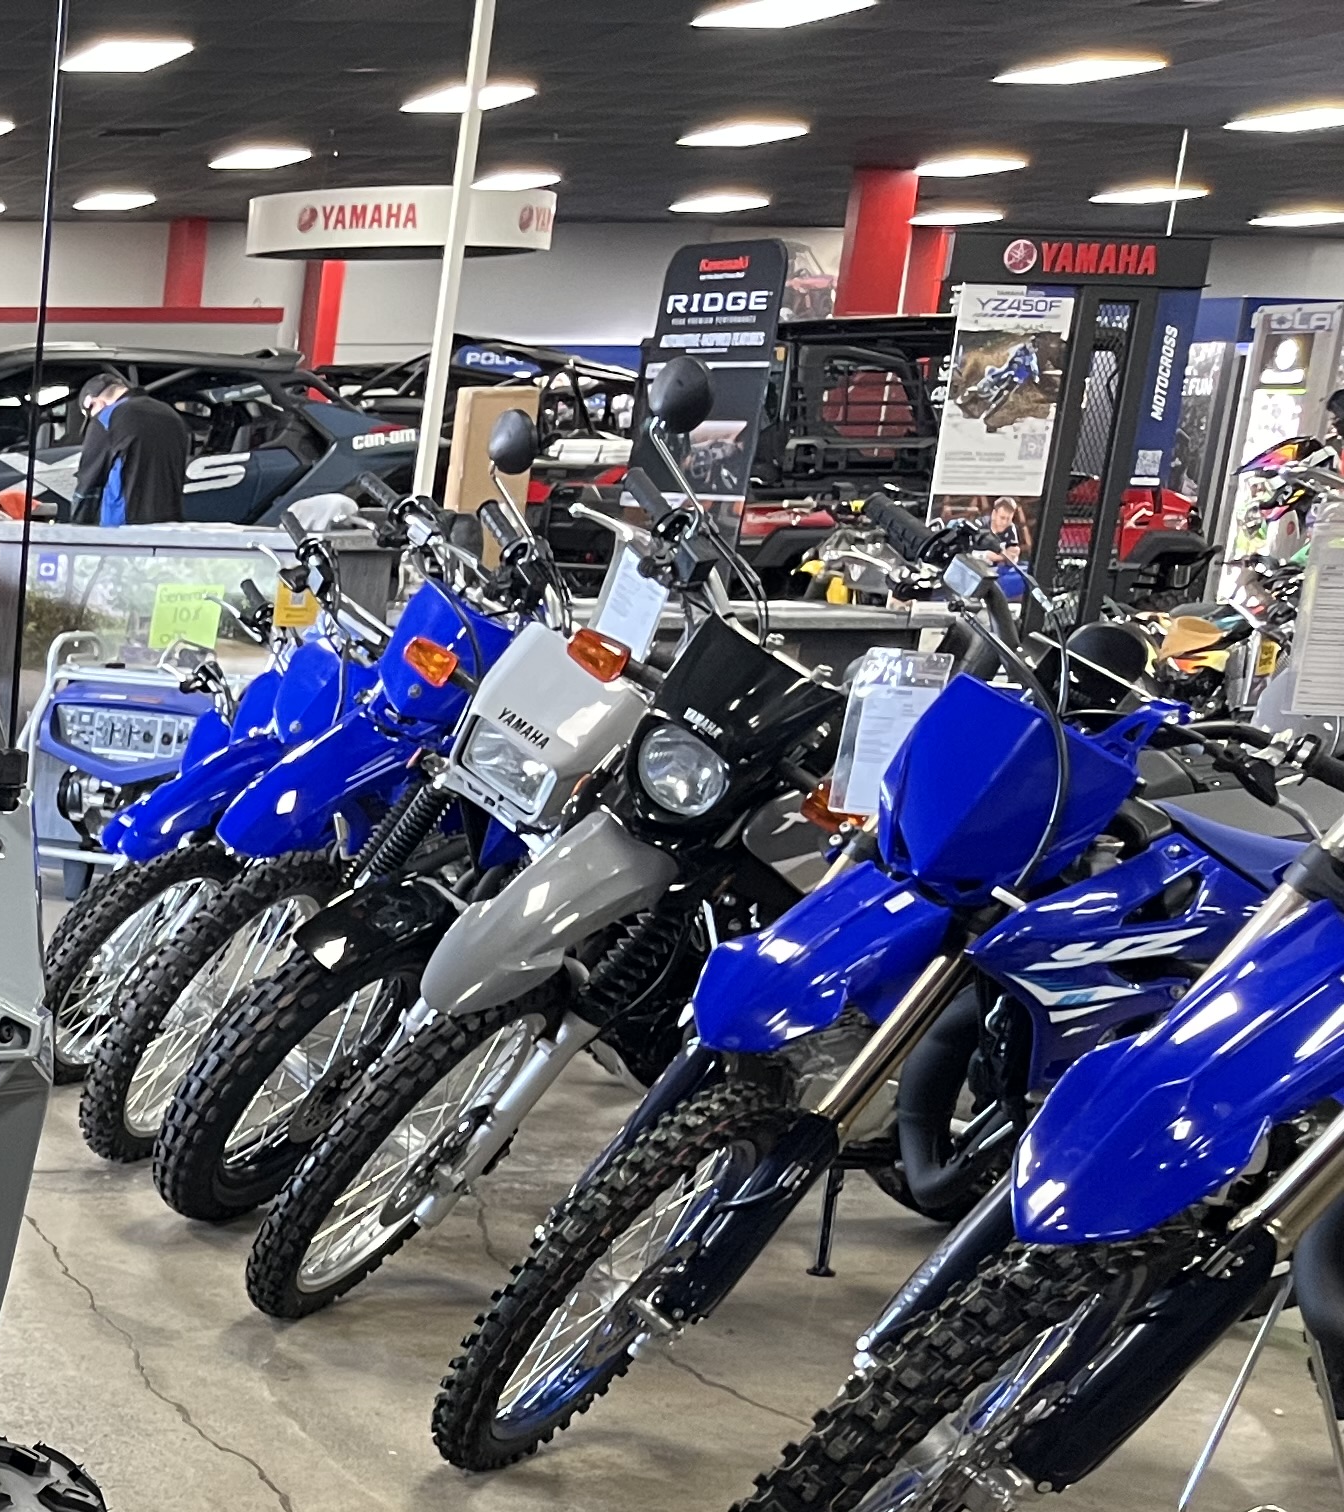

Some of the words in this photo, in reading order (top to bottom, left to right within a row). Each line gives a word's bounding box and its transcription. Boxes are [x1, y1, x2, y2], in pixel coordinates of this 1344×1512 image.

[321, 202, 418, 231] YAMAHA
[1041, 241, 1157, 275] YAMAHA
[666, 290, 769, 314] RIDGE
[976, 297, 1063, 313] YZ450F
[1150, 324, 1179, 421] MOTOCROSS
[352, 428, 417, 451] can-am
[497, 707, 551, 750] YAMAHA
[682, 706, 724, 739] YAMAHA
